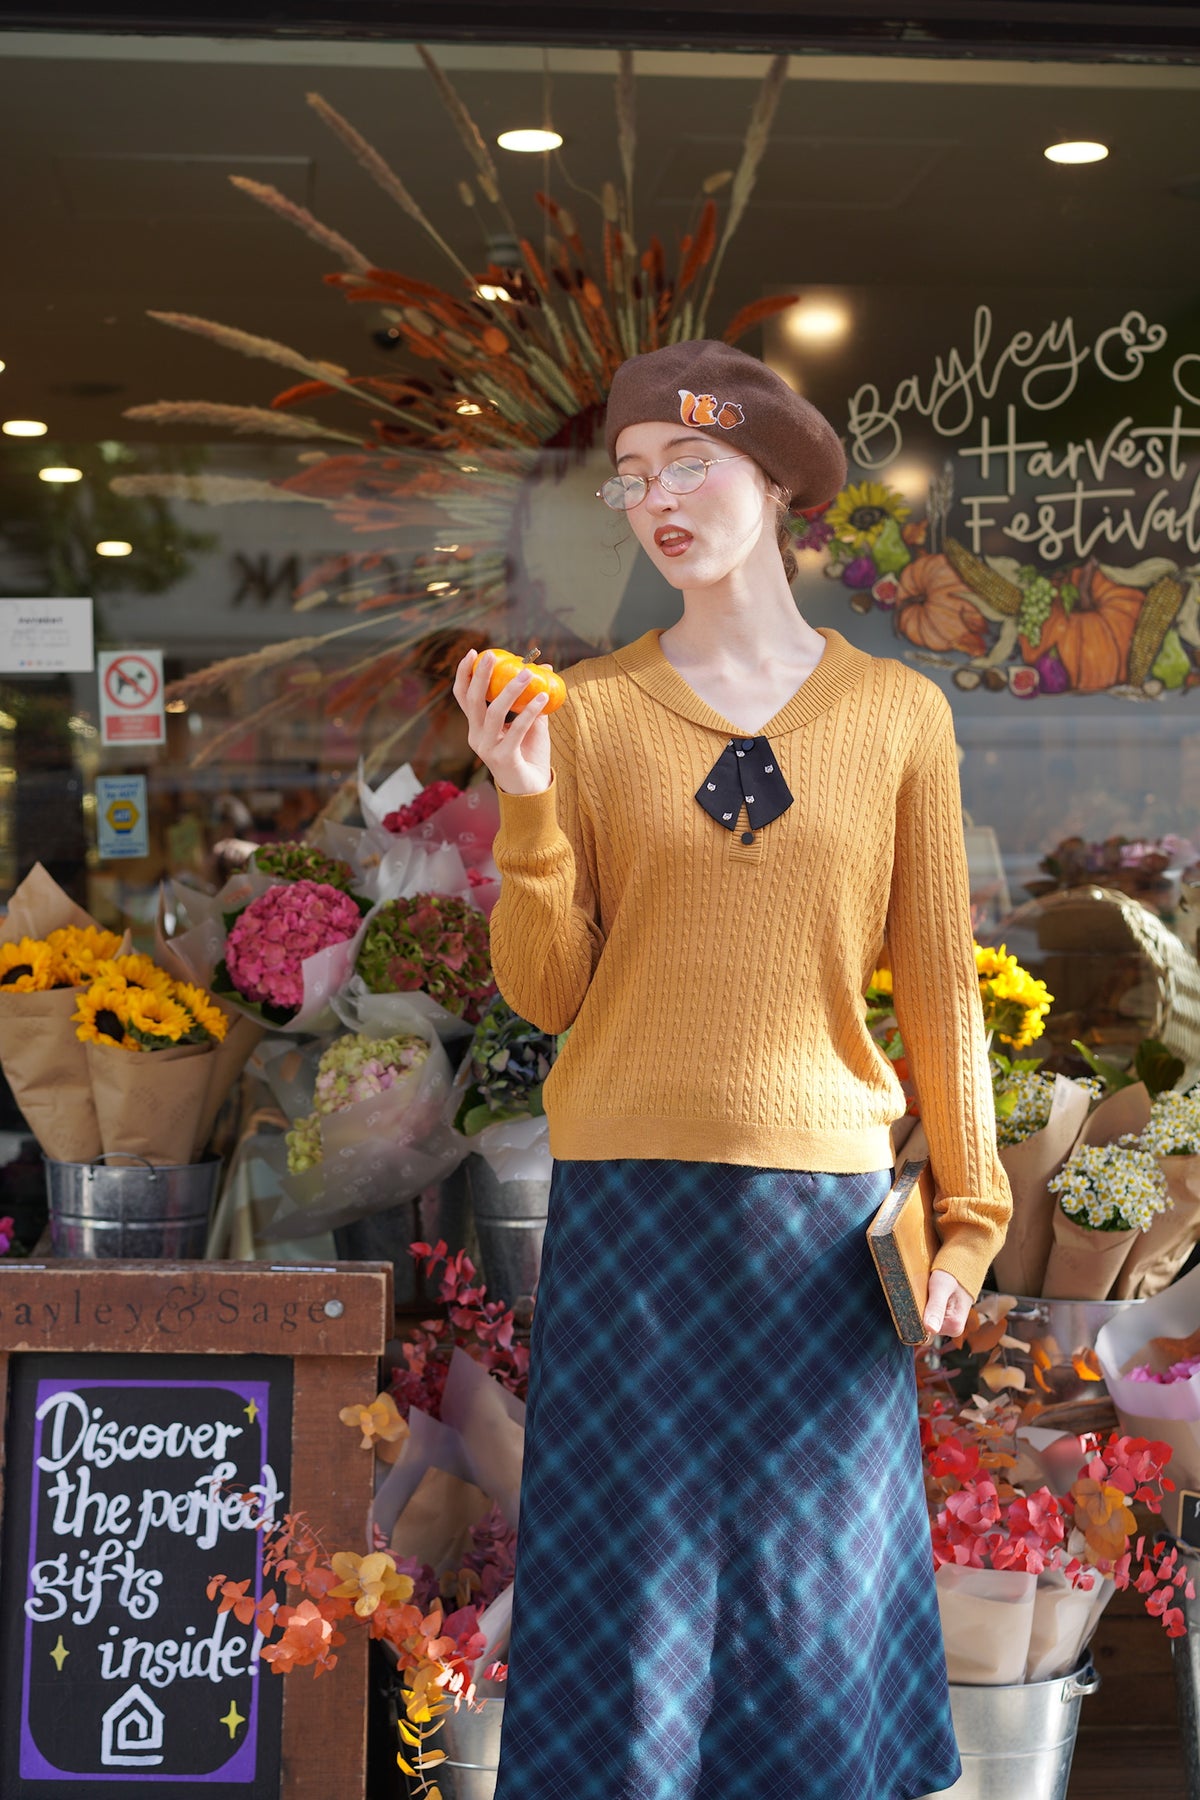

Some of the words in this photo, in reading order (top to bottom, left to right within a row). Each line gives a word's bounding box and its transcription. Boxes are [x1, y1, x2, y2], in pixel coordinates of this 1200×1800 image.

[847, 305, 1090, 469] Bayley
[1095, 311, 1168, 382] &
[958, 404, 1200, 496] Harvest
[961, 473, 1200, 560] Festival
[0, 1289, 145, 1334] ayley
[156, 1286, 207, 1334] &
[216, 1288, 327, 1333] Sage
[36, 1391, 243, 1473] Discover
[47, 1465, 131, 1537] the
[128, 1462, 285, 1550] perfect
[24, 1538, 164, 1625] gifts
[97, 1603, 280, 1688] inside!
